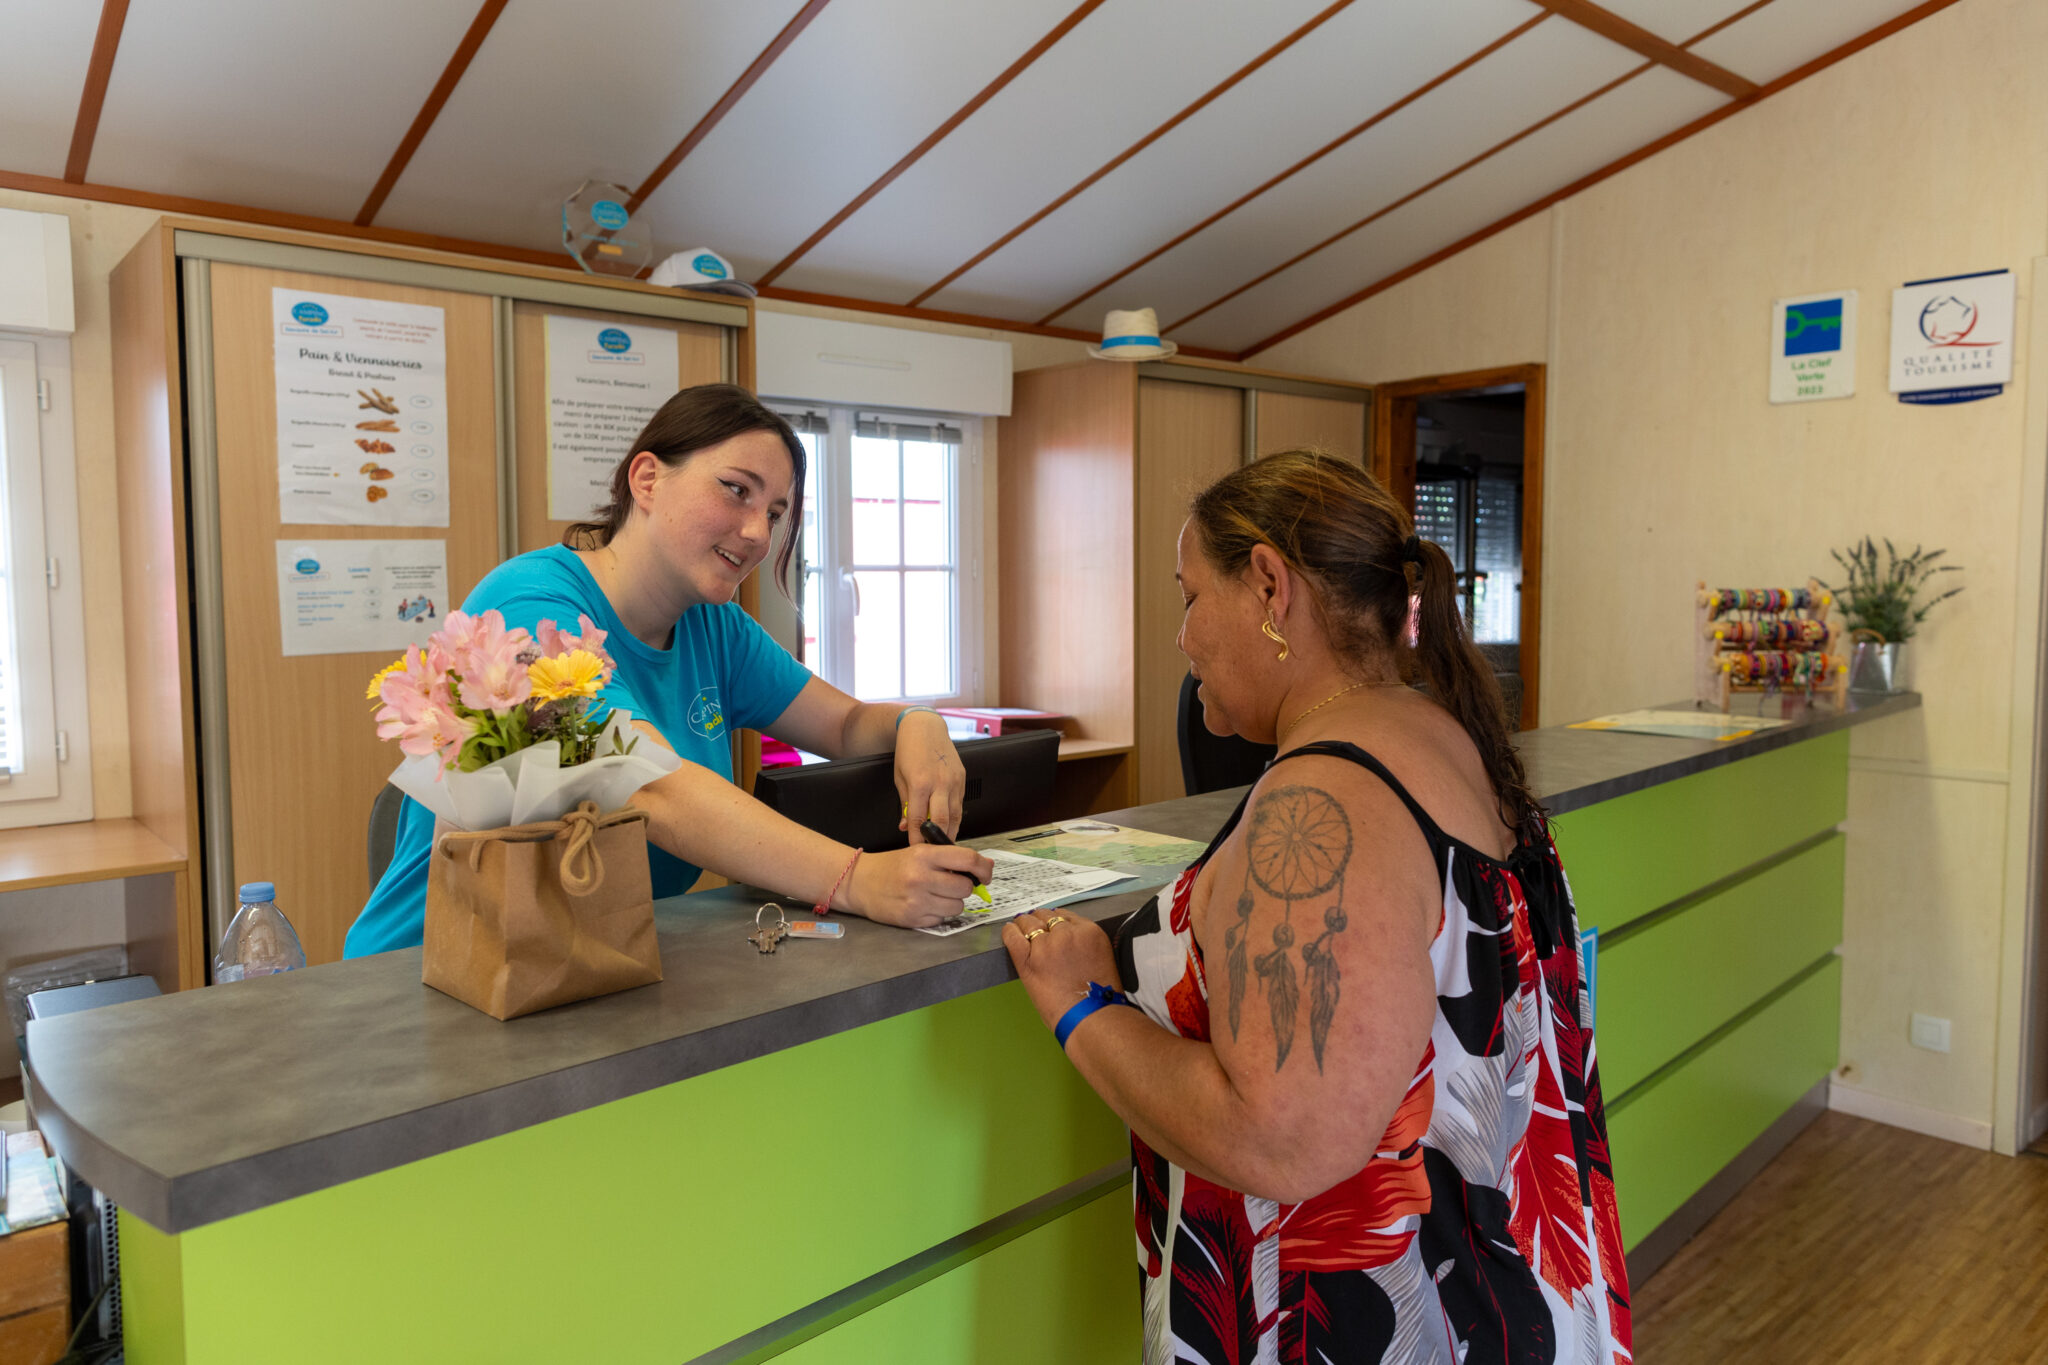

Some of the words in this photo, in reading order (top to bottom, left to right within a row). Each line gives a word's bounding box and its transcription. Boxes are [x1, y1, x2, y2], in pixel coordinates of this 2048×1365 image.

[299, 348, 330, 360] Pain
[333, 351, 342, 362] &
[345, 352, 422, 369] Viennoiseries
[1808, 357, 1832, 368] Clef
[1904, 348, 1993, 367] QUALITÉ
[1905, 360, 1992, 376] TOURISME
[1795, 373, 1825, 382] Verte
[614, 379, 646, 389] Bienvenue
[566, 398, 575, 406] de
